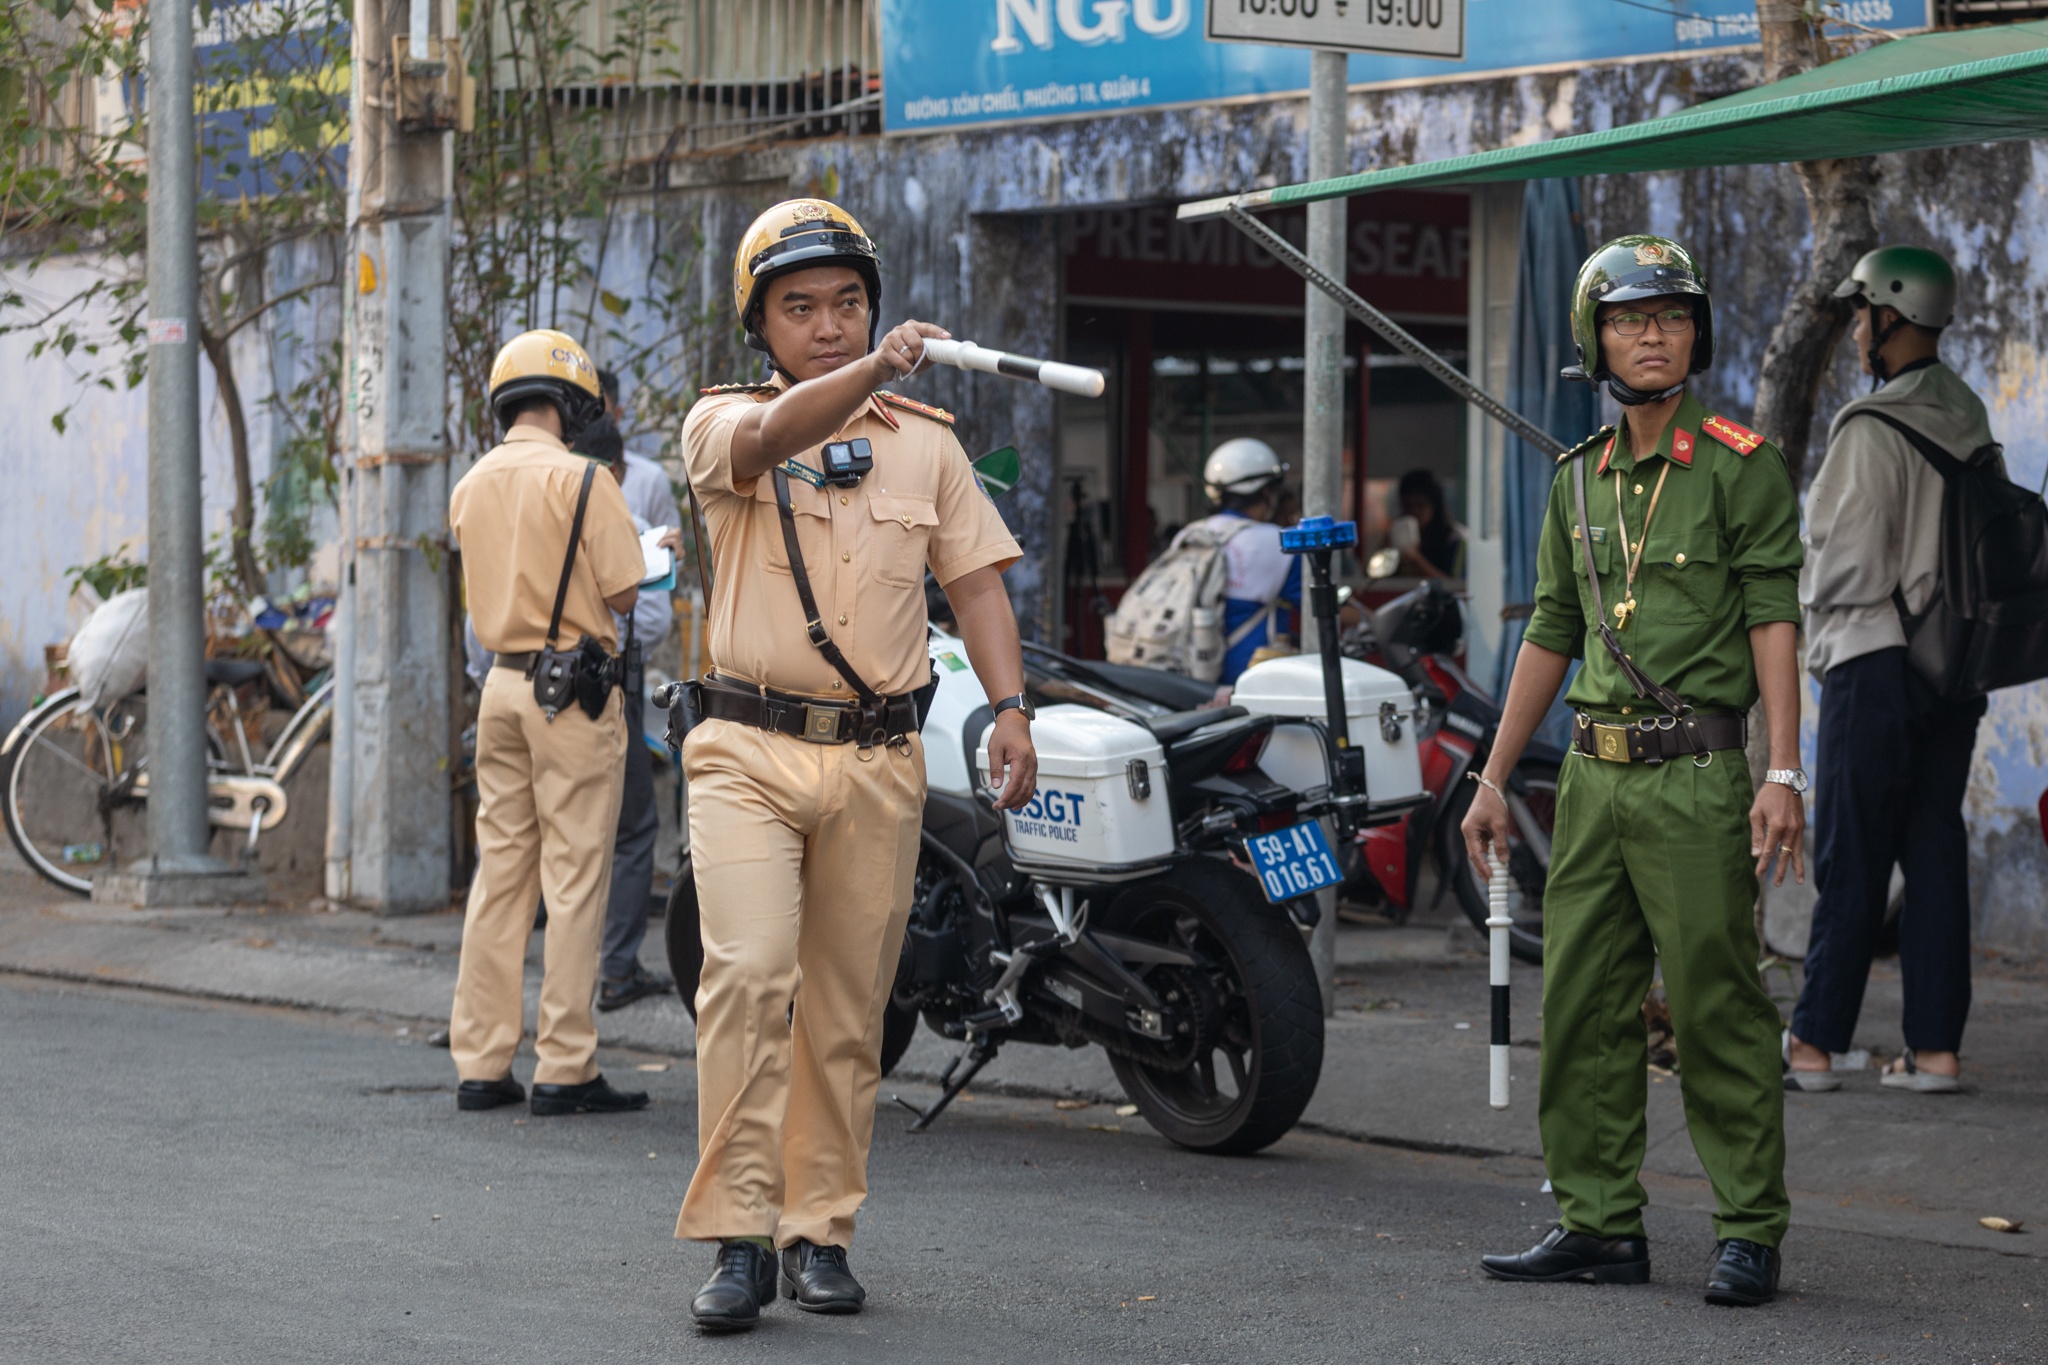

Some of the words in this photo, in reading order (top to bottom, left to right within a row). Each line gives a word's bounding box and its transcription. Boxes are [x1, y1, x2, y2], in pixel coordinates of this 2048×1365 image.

[1014, 819, 1047, 838] TRAFFIC
[1048, 825, 1078, 843] POLICE
[1255, 824, 1318, 867] 59-A1
[1265, 852, 1337, 898] 016.61
